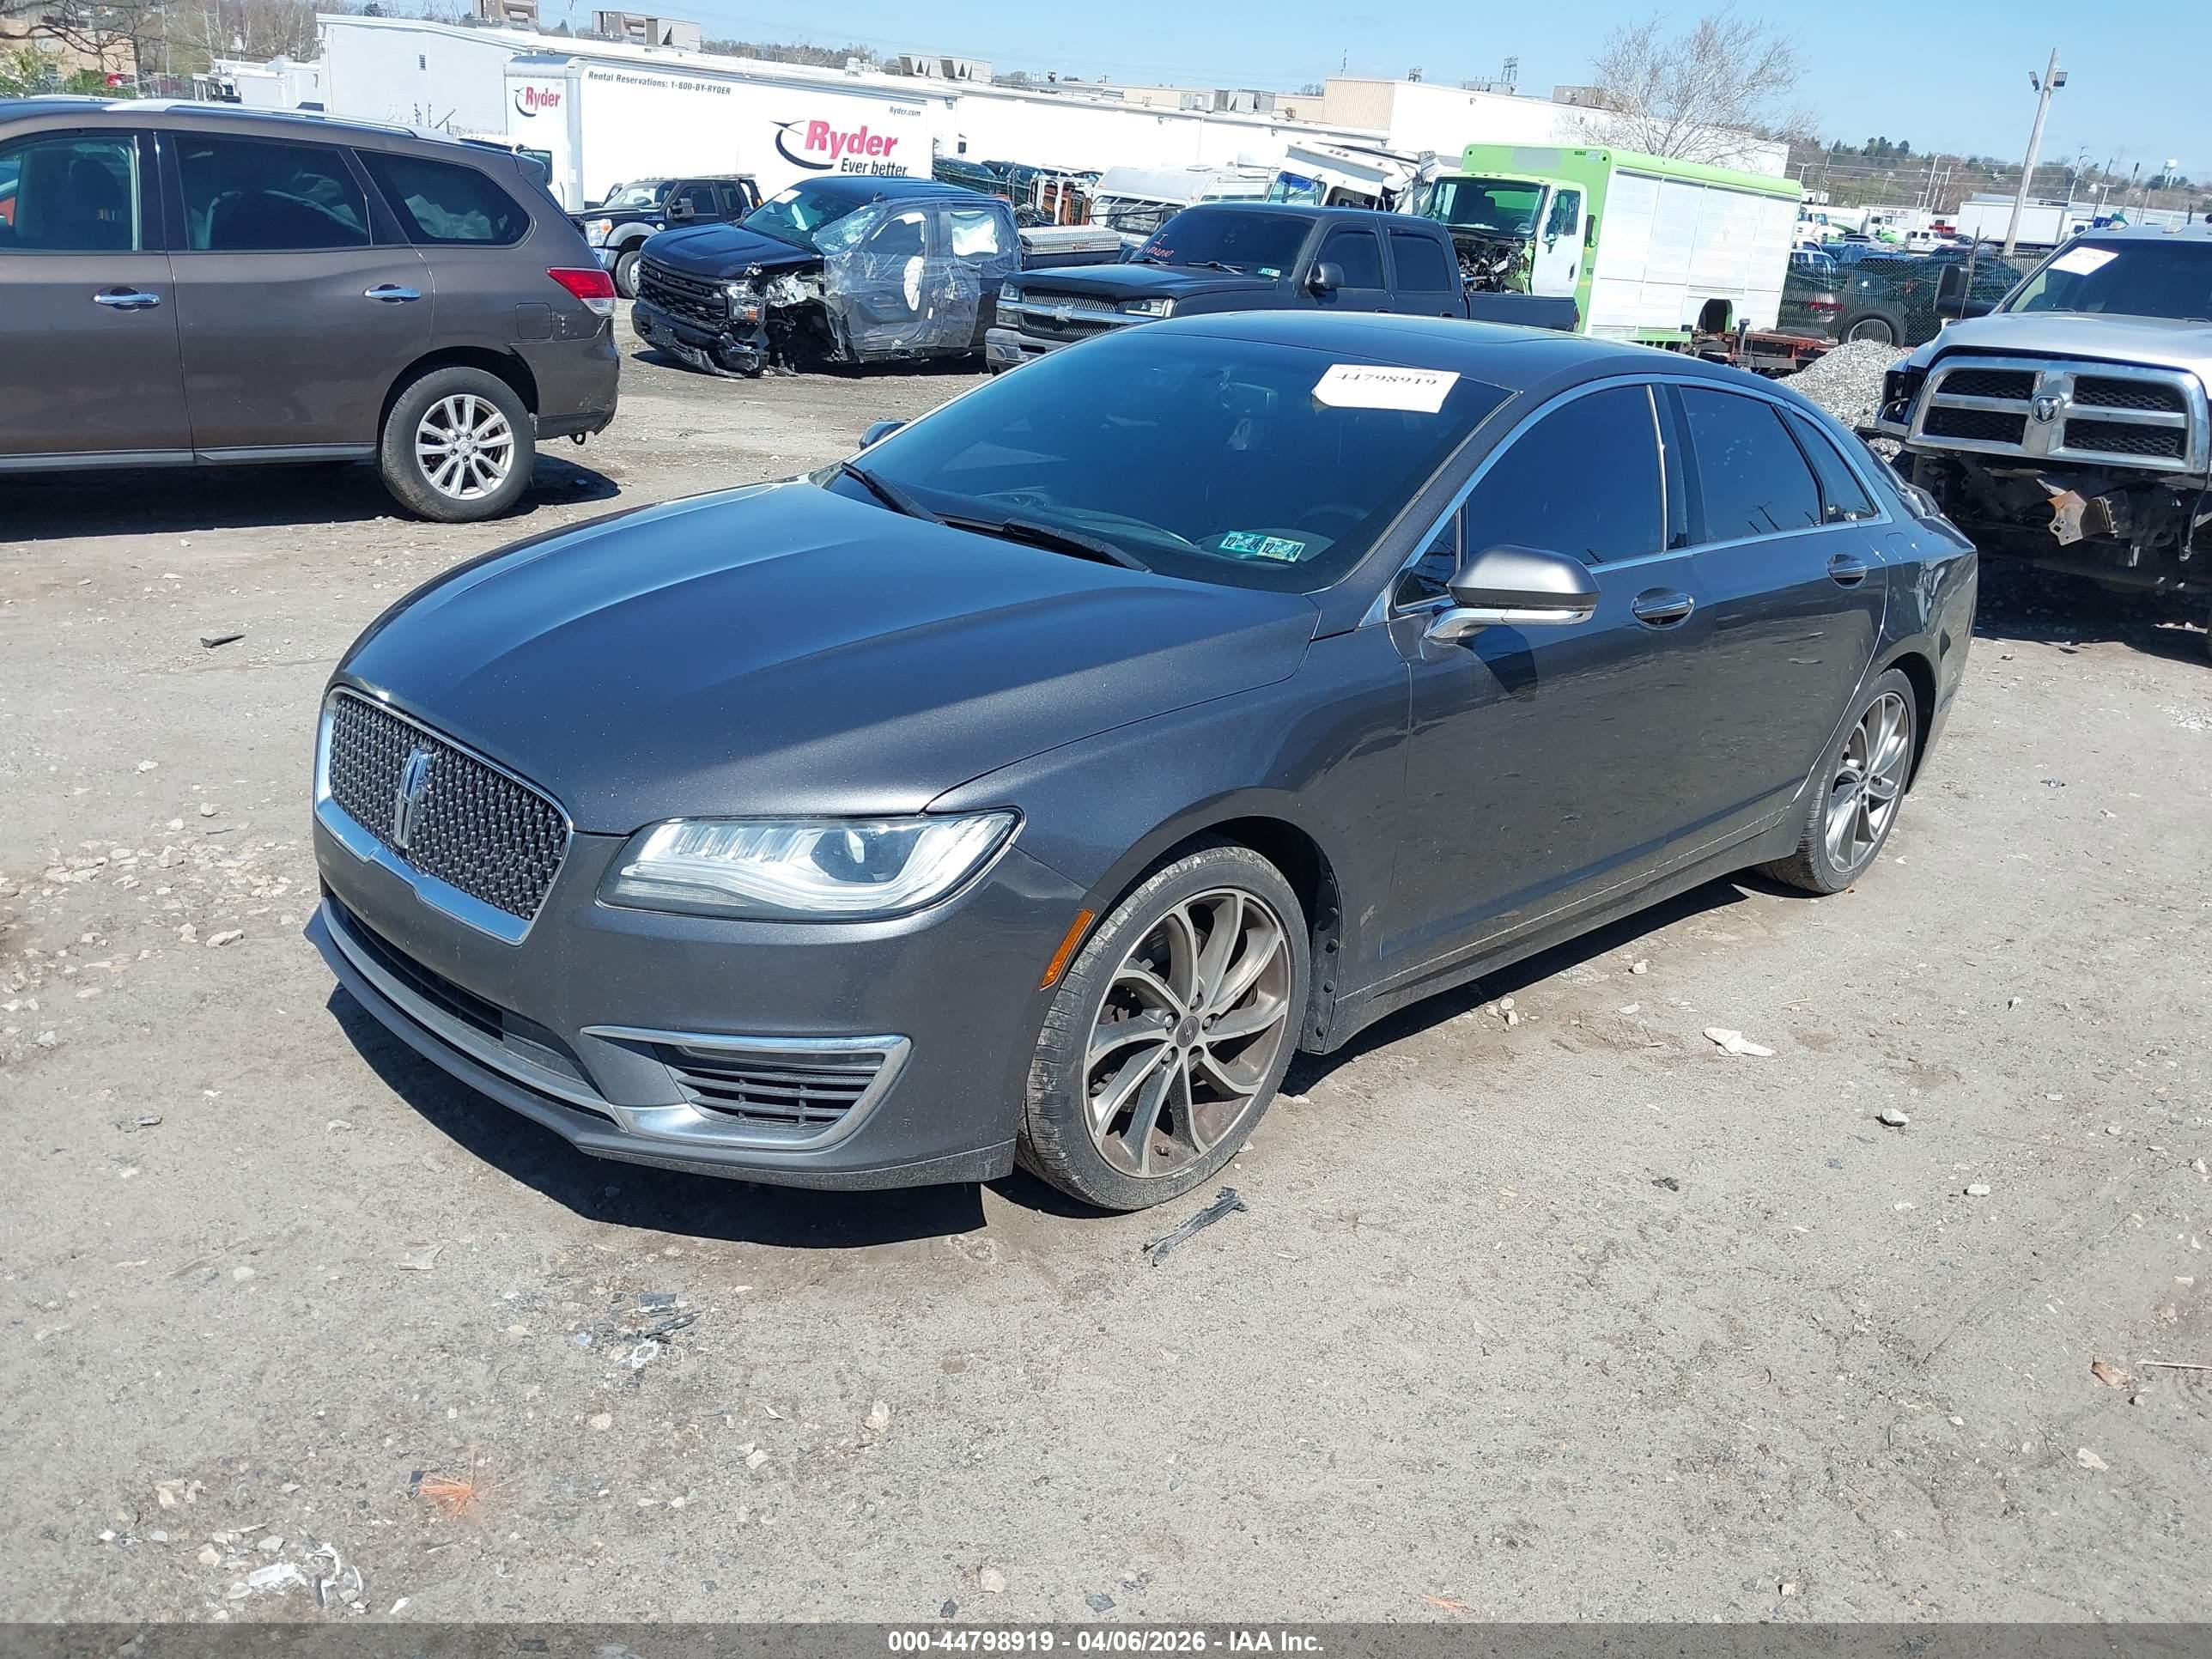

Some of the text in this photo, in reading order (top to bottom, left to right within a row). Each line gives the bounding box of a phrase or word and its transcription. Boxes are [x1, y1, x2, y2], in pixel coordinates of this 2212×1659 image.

[588, 71, 731, 95] Rental Reservations: 1-800-BY-RYDER
[526, 86, 561, 111] Ryder
[890, 106, 921, 117] Ryder.com
[805, 119, 899, 160] Ryder
[841, 158, 869, 174] Ever
[1336, 373, 1437, 386] 44798919
[1224, 536, 1238, 547] 12
[1262, 543, 1276, 554] 12
